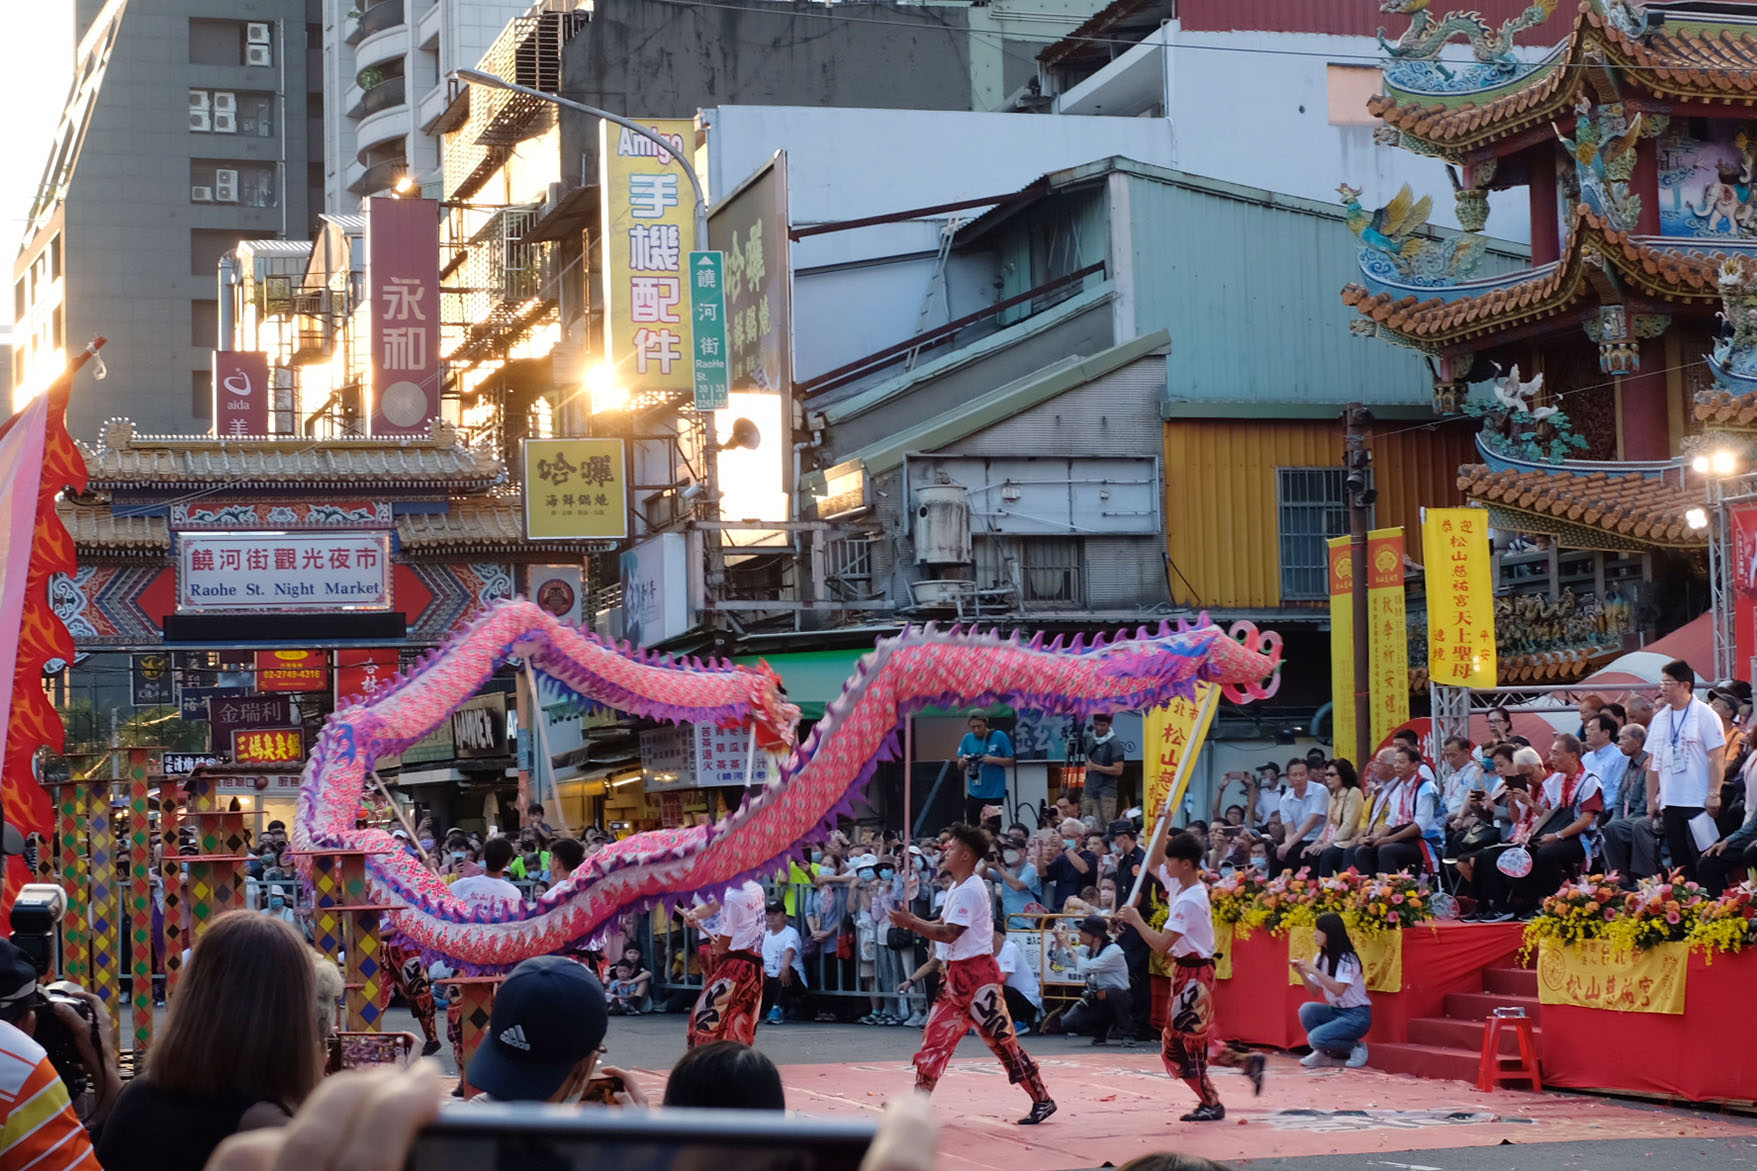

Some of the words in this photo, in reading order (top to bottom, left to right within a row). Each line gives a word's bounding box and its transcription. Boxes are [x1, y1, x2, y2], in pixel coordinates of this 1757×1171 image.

[617, 126, 684, 165] Amigo
[629, 173, 681, 375] 手機配件
[382, 276, 426, 370] 永和
[696, 268, 720, 356] 饒河街
[696, 359, 724, 369] RaoHe
[696, 371, 708, 381] St.
[226, 400, 251, 410] aida
[191, 547, 378, 572] 饒河街觀光夜市
[190, 583, 236, 597] Raohe
[246, 583, 264, 596] St.
[274, 582, 315, 598] Night
[324, 581, 379, 595] Market
[1480, 629, 1491, 662] 平安
[219, 702, 281, 723] 金瑞利
[236, 732, 302, 761] 三媽臭臭鍋
